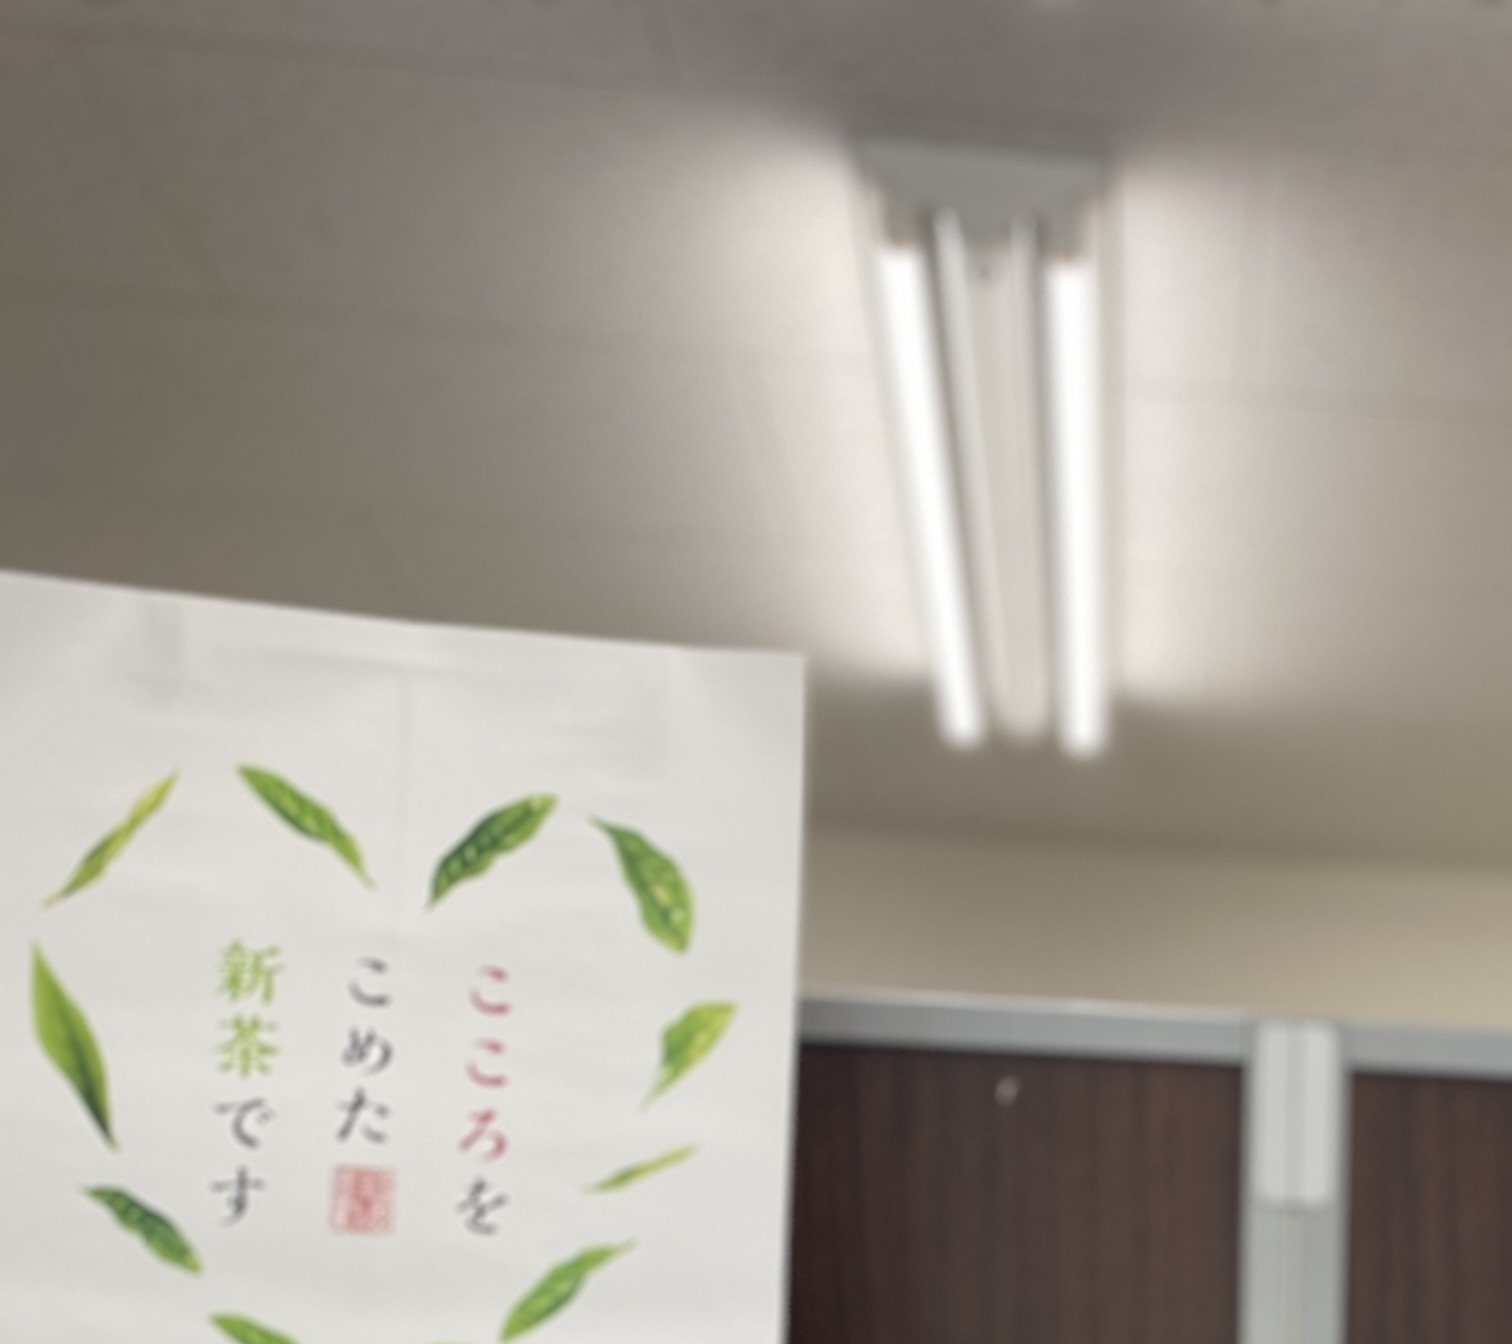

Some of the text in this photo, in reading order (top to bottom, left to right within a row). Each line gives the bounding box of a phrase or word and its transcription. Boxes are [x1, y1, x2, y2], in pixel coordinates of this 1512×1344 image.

[211, 939, 284, 1227] 新茶です
[336, 956, 393, 1145] こめた
[456, 965, 511, 1235] こころを
